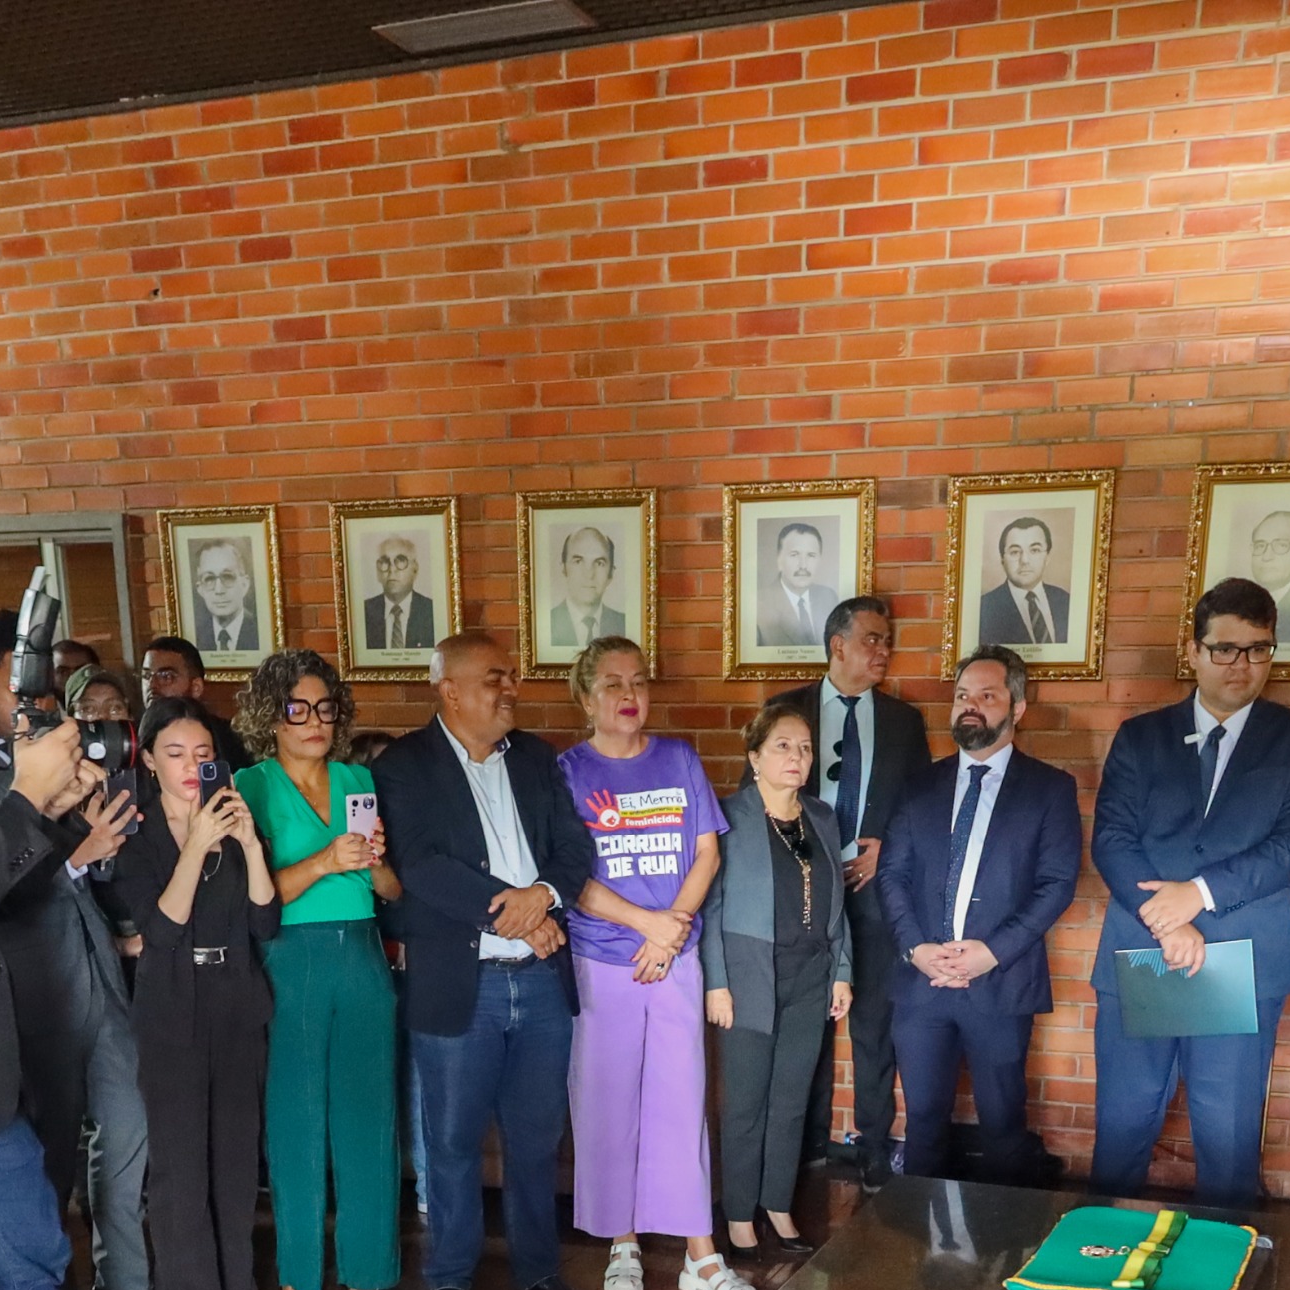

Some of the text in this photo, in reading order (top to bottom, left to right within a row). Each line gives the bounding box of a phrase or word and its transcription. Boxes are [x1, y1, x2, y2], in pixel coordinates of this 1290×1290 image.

[595, 833, 682, 857] CORRIDA
[606, 855, 678, 879] DE RUA
